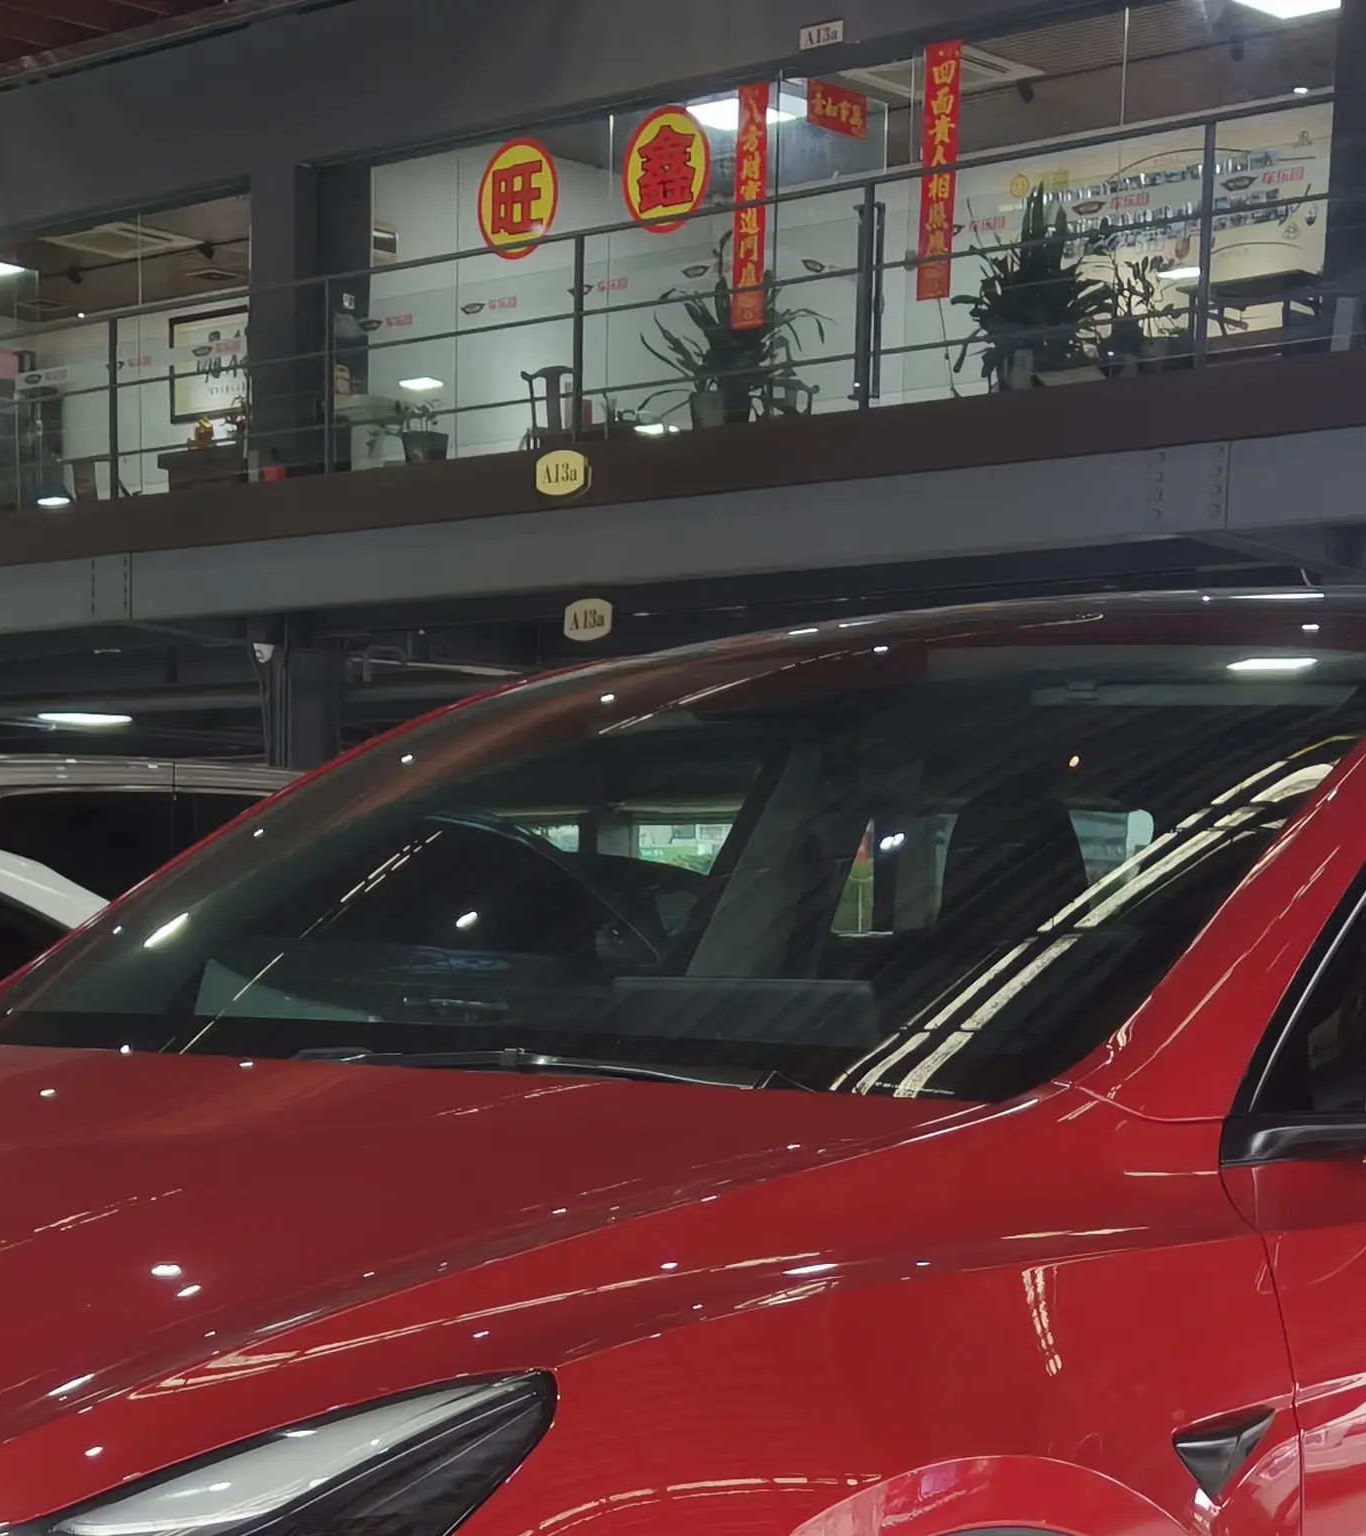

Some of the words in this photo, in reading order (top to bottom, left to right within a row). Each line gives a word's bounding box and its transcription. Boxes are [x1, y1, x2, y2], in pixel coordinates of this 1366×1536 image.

[805, 26, 837, 46] A13a
[637, 125, 695, 213] 鑫
[492, 160, 543, 235] 旺
[542, 463, 577, 484] A13a
[569, 608, 605, 631] A13a
